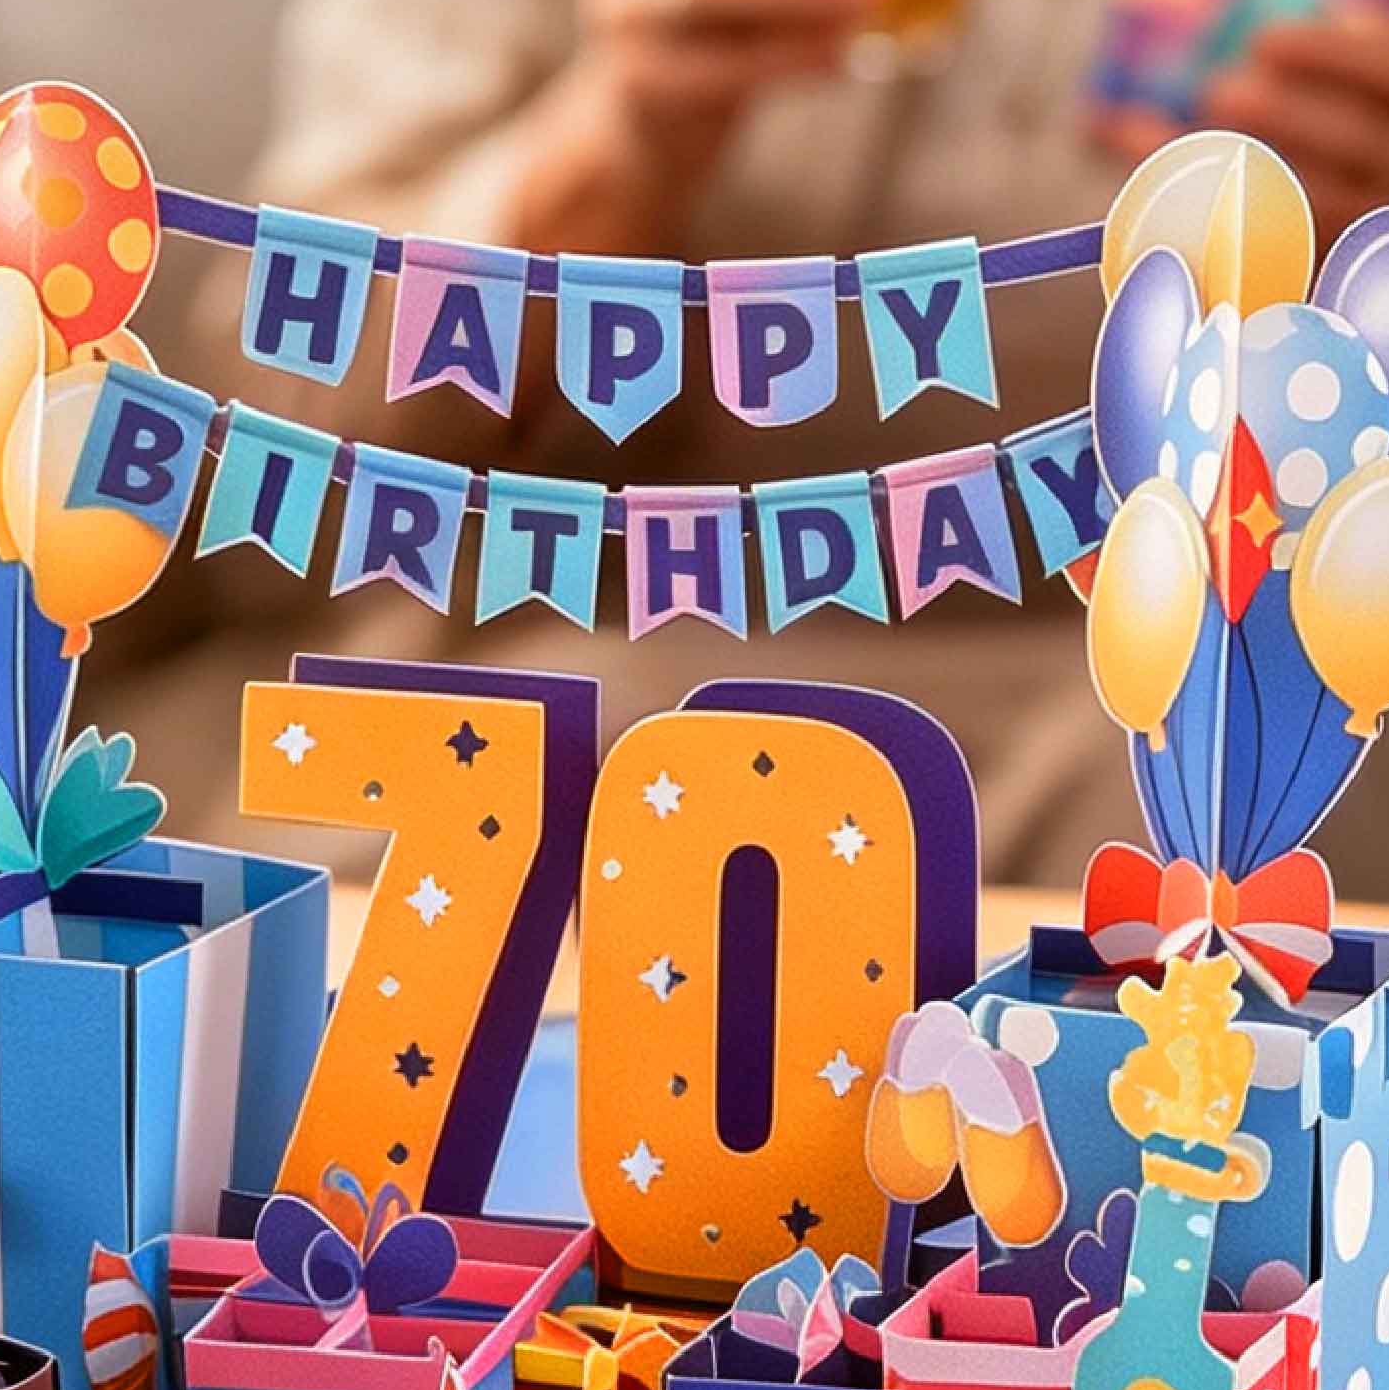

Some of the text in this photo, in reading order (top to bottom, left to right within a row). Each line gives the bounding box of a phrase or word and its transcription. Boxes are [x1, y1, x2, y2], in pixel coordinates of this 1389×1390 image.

[253, 252, 961, 410] HAPPY
[95, 398, 1109, 615] BIRTHDAY
[239, 680, 919, 1287] 70
